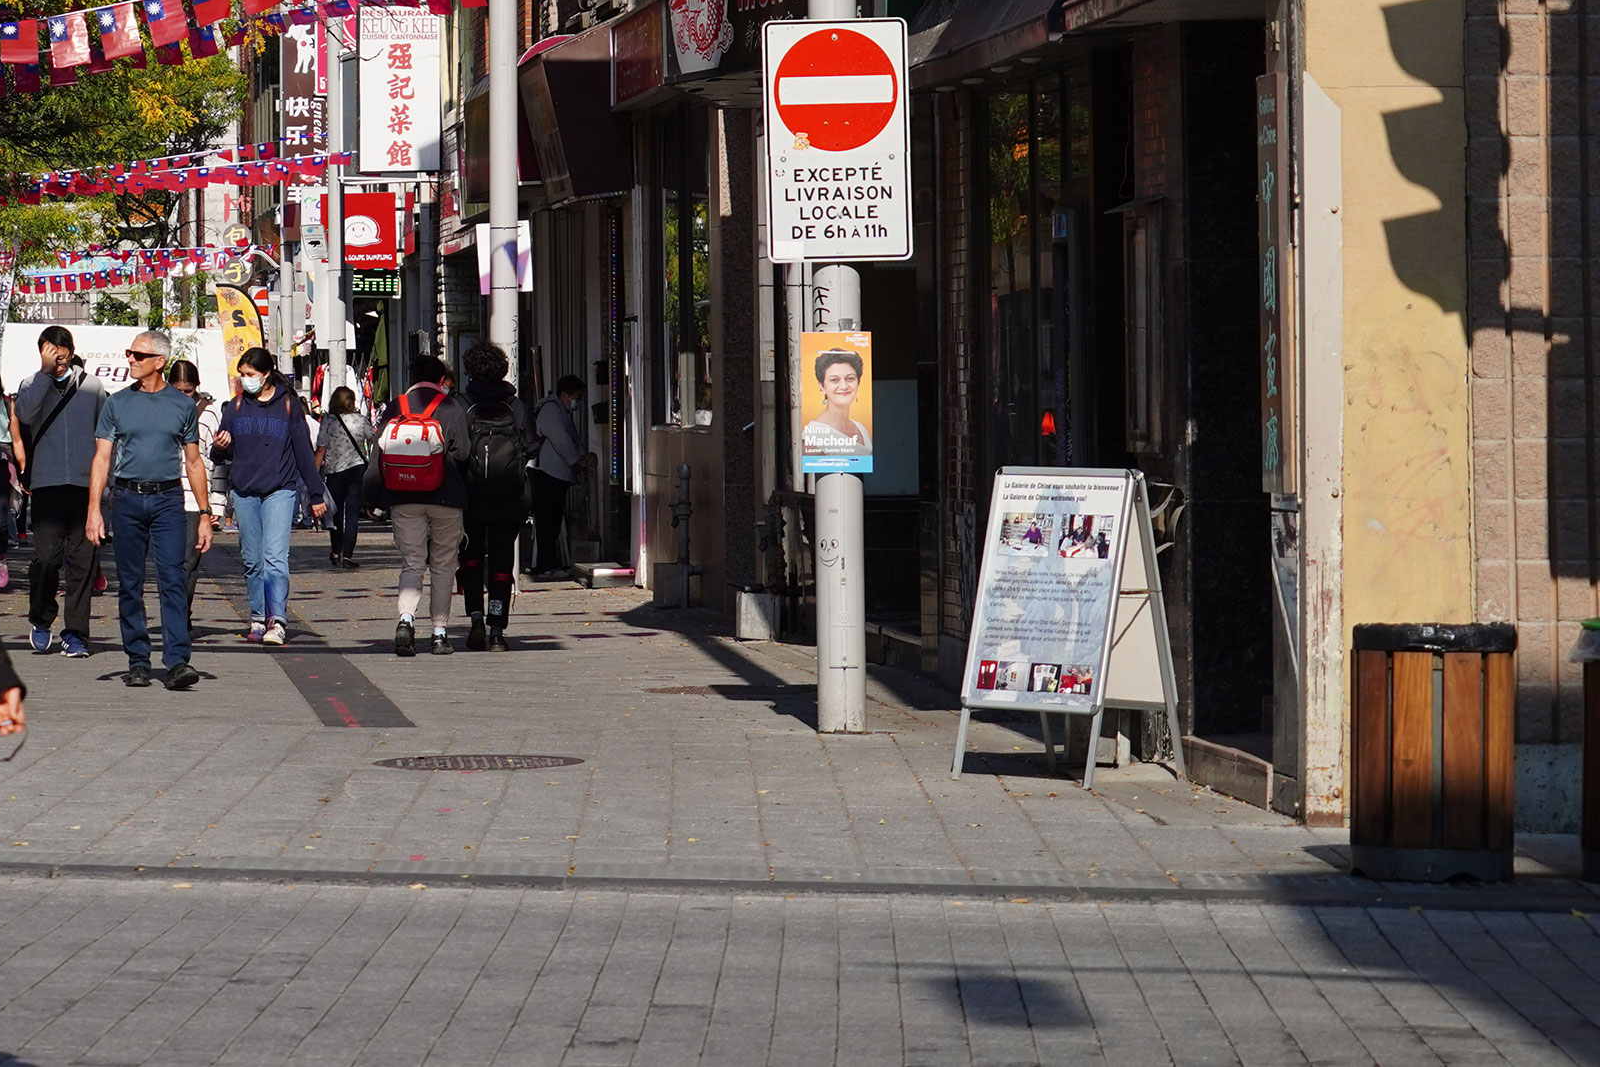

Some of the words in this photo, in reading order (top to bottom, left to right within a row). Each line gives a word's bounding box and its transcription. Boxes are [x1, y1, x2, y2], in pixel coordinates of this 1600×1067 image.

[362, 18, 409, 34] KEUNG
[412, 18, 438, 34] KEE
[794, 162, 883, 183] EXCEPTÉ
[785, 186, 892, 202] LIVRAISON
[800, 205, 879, 221] LOCALE
[792, 225, 816, 240] DE
[823, 224, 847, 239] 6h
[864, 224, 888, 238] 11h
[804, 424, 830, 434] Nima
[805, 435, 858, 447] Machouf
[1076, 495, 1088, 503] you!
